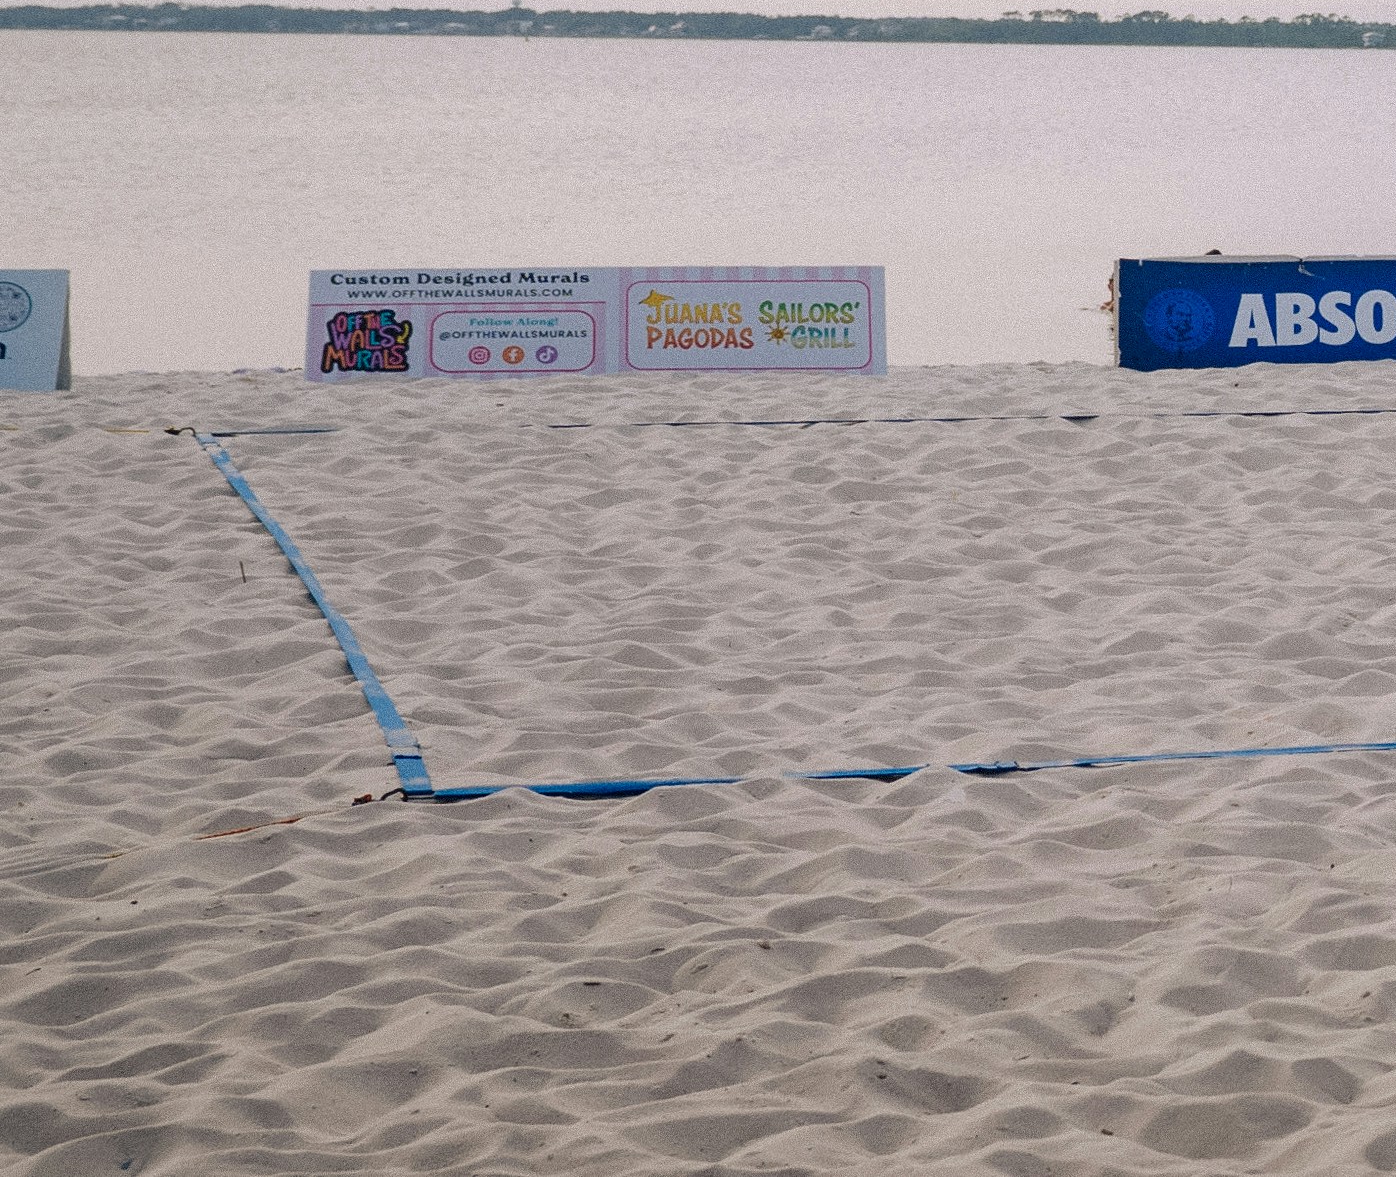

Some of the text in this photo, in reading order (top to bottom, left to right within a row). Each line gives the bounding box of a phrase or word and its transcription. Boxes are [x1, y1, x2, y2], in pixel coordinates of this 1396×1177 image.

[330, 271, 591, 287] Custom Designed Murals
[347, 287, 574, 299] WWW.OFFTHEWALLSMURALS.COM
[468, 317, 515, 327] Follow
[646, 301, 743, 325] JUANA'S
[758, 300, 860, 324] SAILORS'
[332, 322, 402, 351] WALLS
[439, 329, 588, 341] @OFFTHEWALLSMURALS
[646, 326, 755, 349] PAGODAS
[790, 325, 856, 349] GRILL
[324, 344, 407, 371] MURALS
